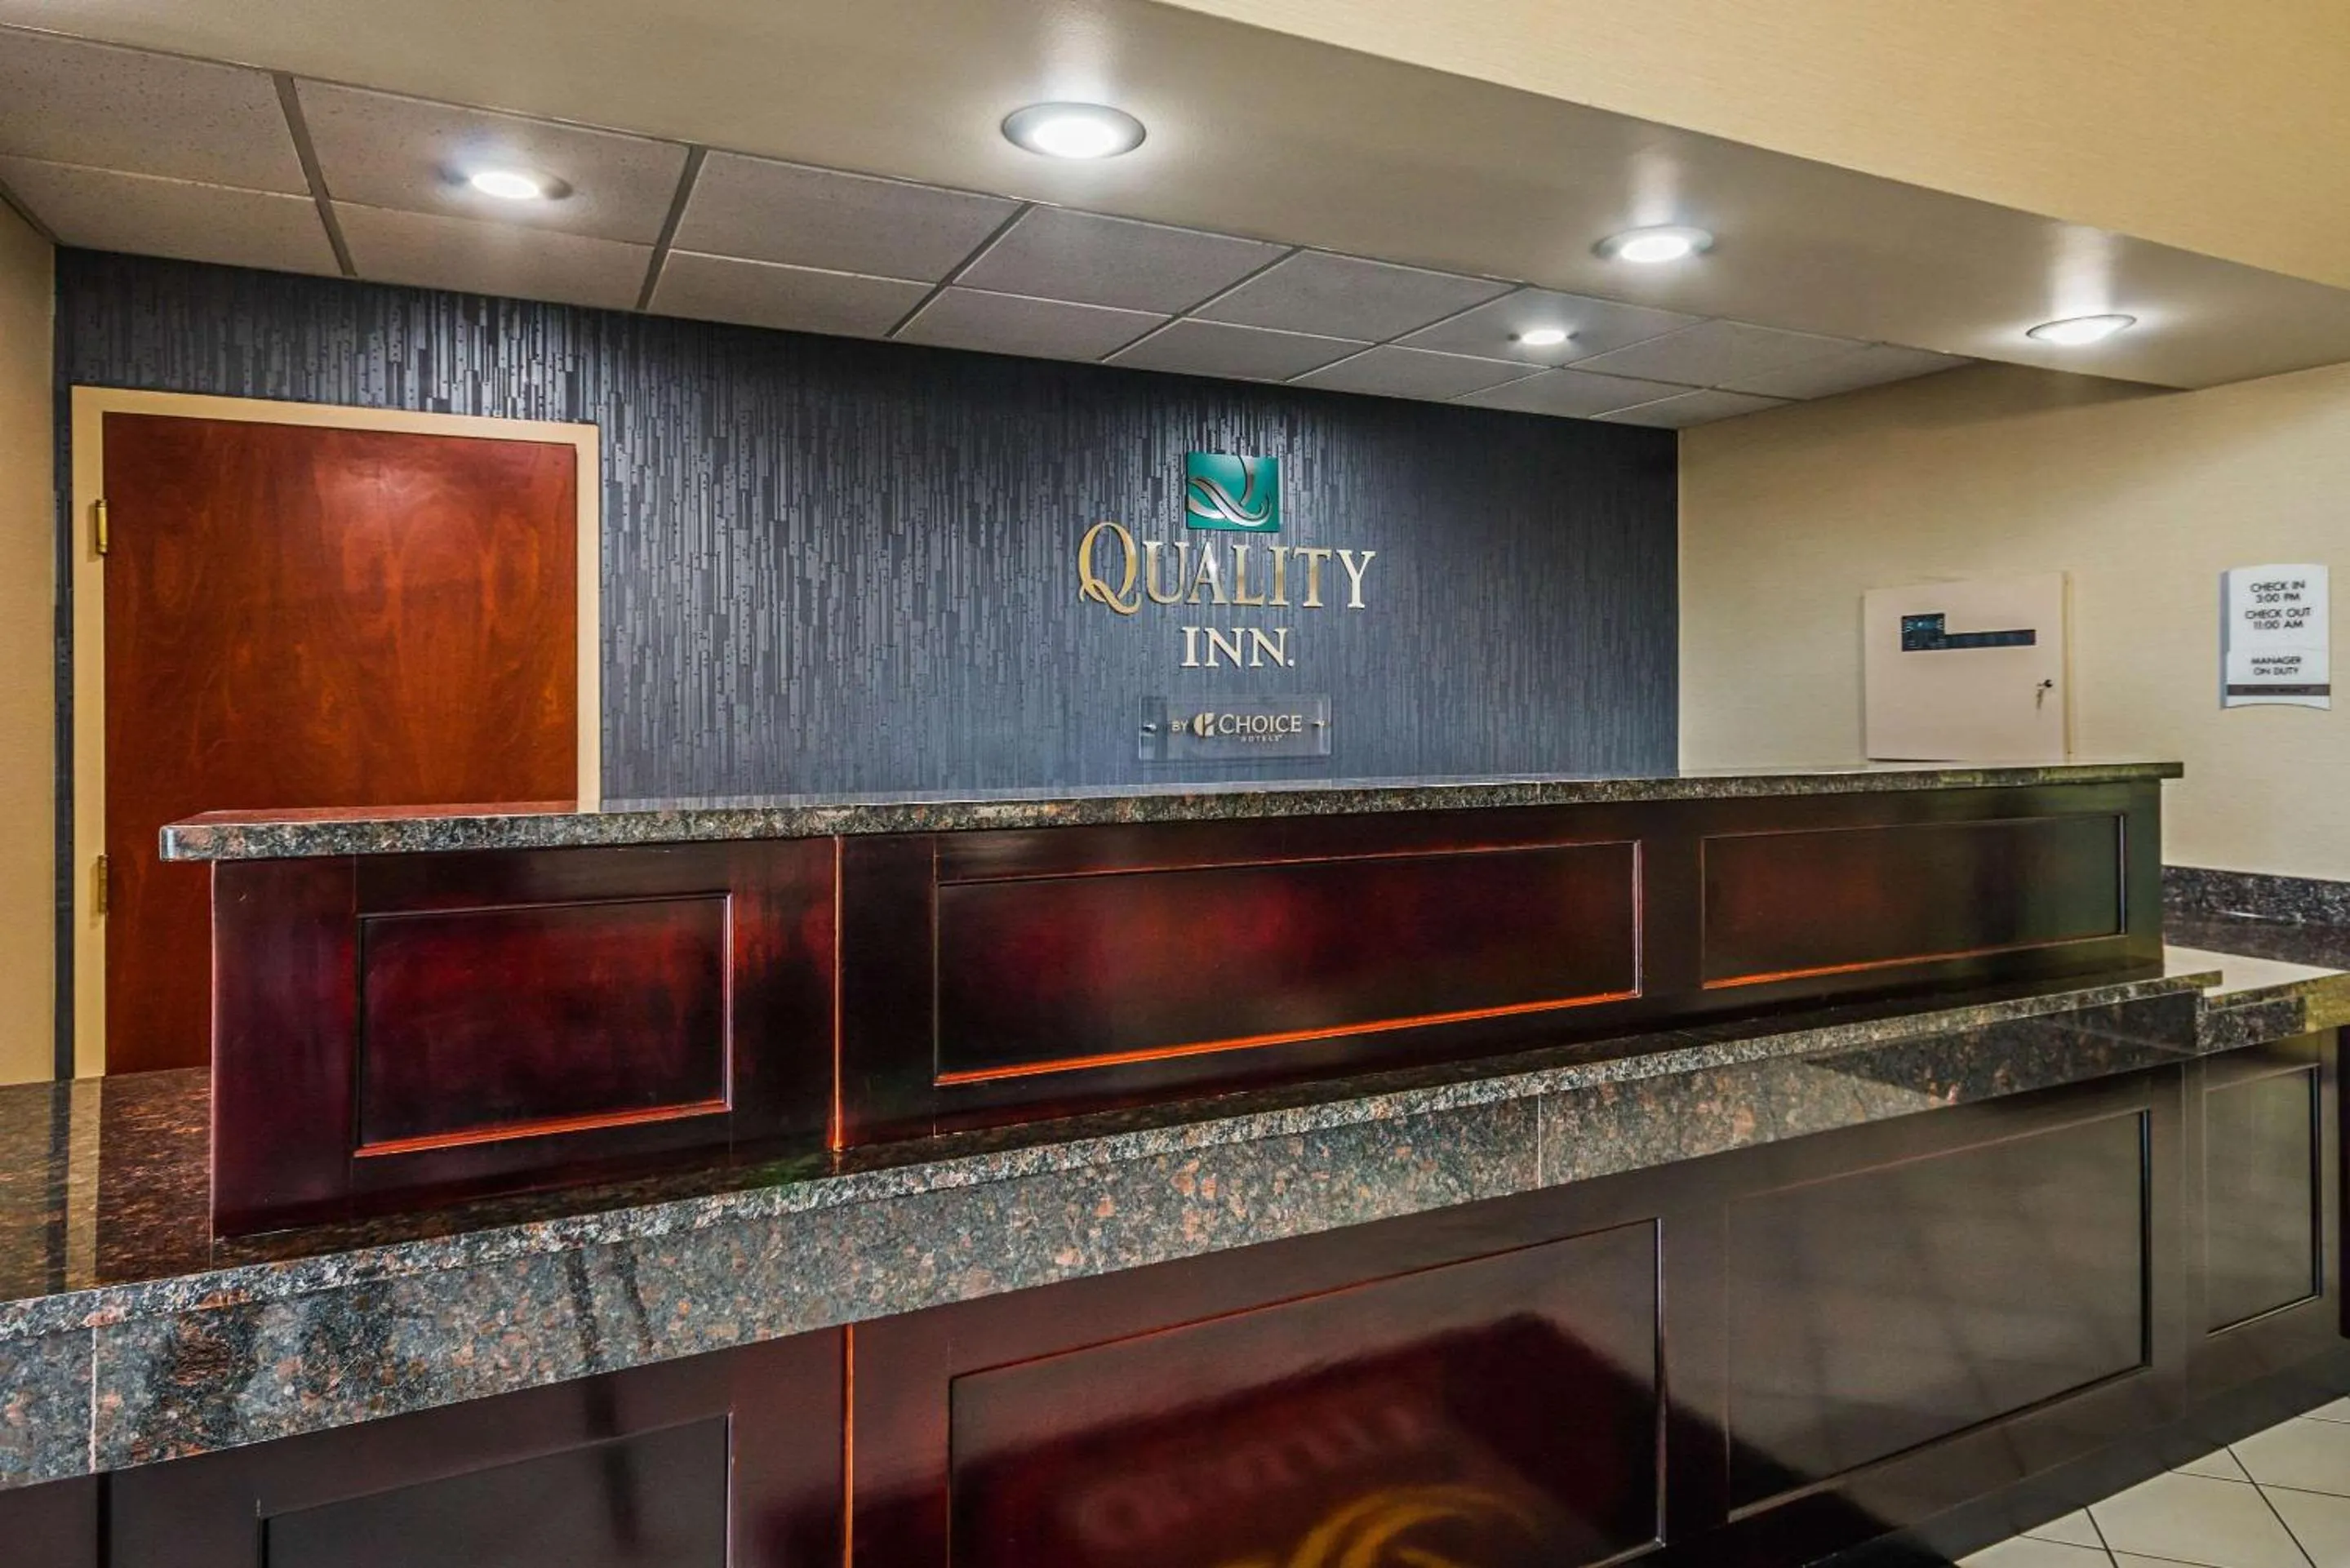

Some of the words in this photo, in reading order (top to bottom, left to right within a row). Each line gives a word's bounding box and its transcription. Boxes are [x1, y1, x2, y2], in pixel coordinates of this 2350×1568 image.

[1078, 522, 1377, 615] QUALITY
[2250, 582, 2288, 593] CHECK
[2292, 580, 2305, 589] IN
[2284, 593, 2300, 602] PM
[2245, 609, 2281, 619] CHECK
[2286, 607, 2310, 618] OUT
[2254, 620, 2279, 629] 11:00
[2283, 620, 2303, 629] AM
[2250, 655, 2302, 664] MANAGER
[2254, 667, 2271, 676] ON
[2273, 667, 2299, 676] DUTY
[1171, 720, 1188, 732] BY
[1219, 713, 1303, 735] CHOICE
